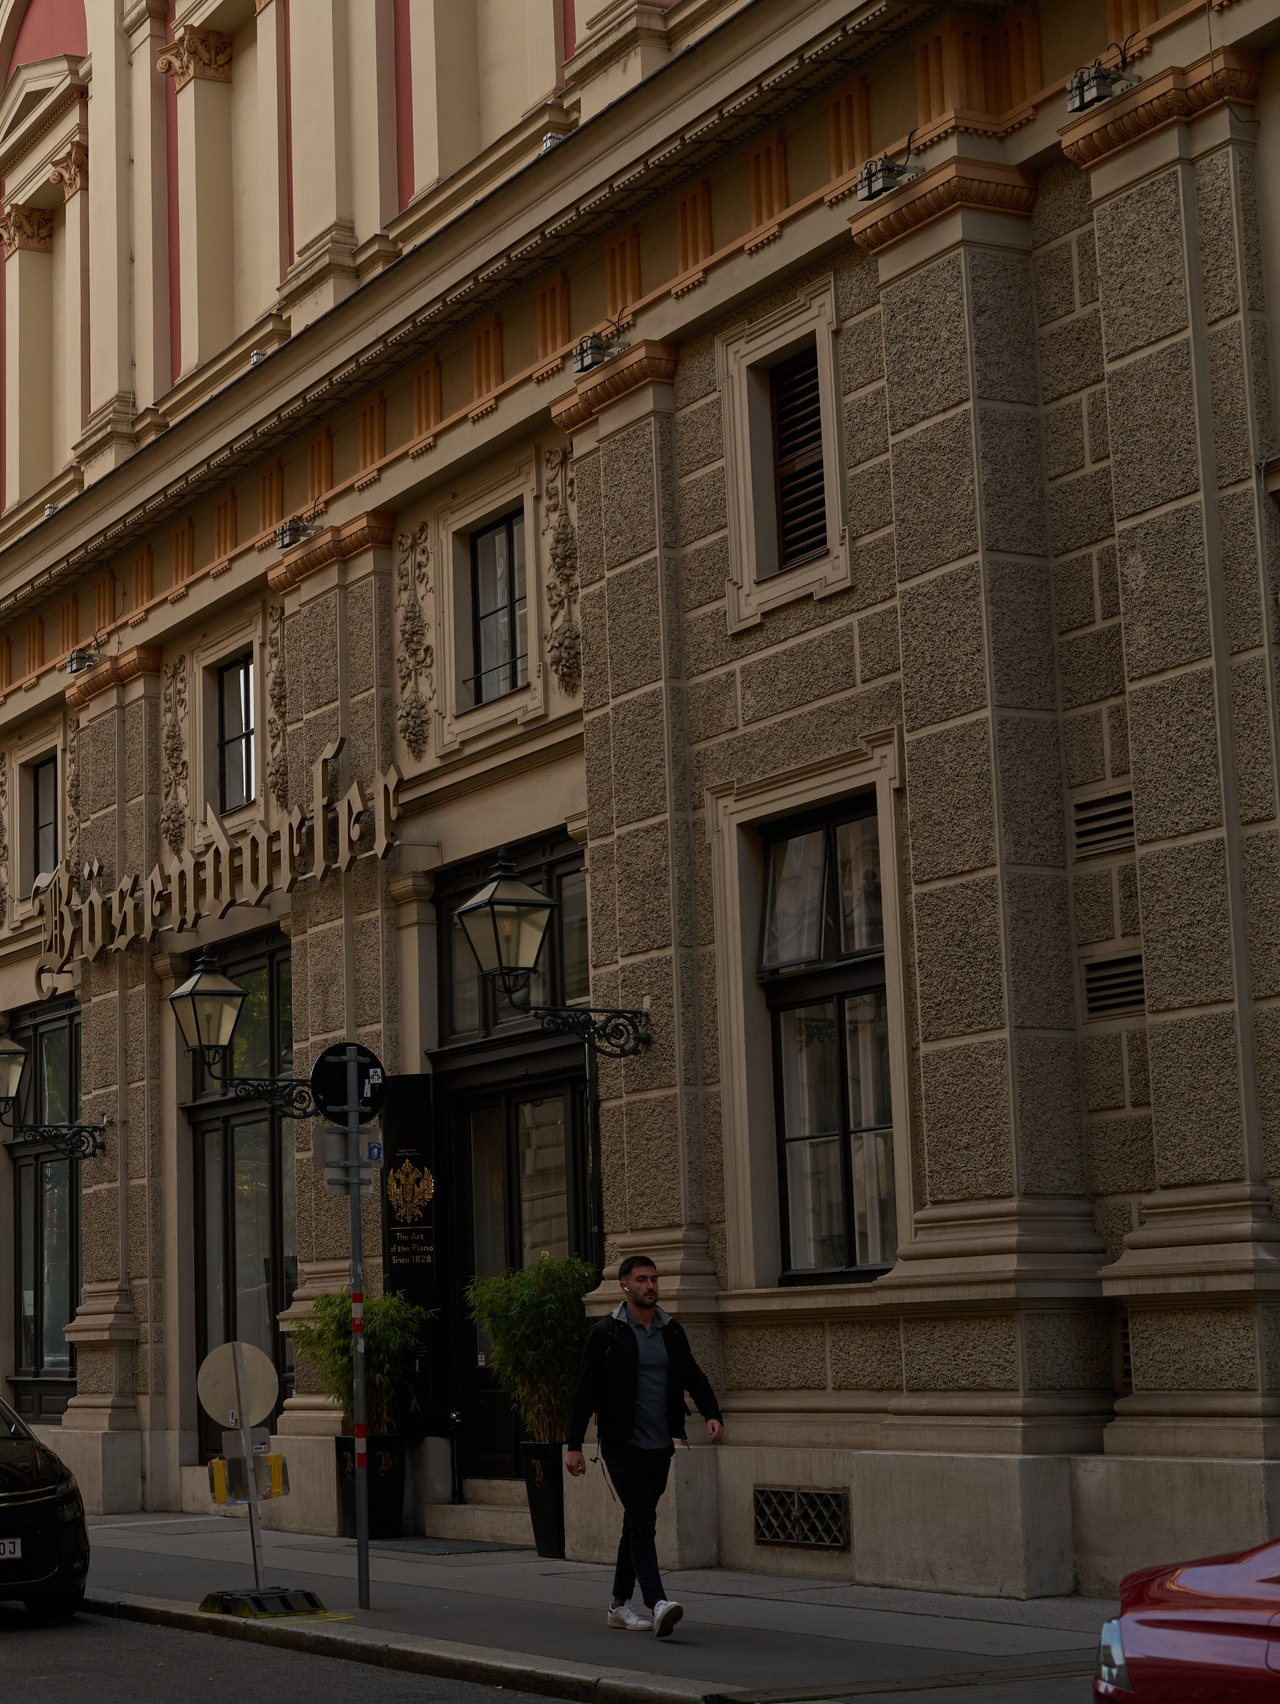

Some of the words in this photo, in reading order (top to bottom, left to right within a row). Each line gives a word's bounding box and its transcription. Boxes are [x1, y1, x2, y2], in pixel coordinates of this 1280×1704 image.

[32, 736, 405, 1000] Bösendorfer
[396, 1232, 409, 1240] The
[411, 1232, 424, 1240] Art
[390, 1244, 397, 1252] of
[397, 1244, 410, 1252] the
[411, 1243, 434, 1252] Piano
[392, 1255, 410, 1264] Since
[412, 1254, 432, 1263] 1828
